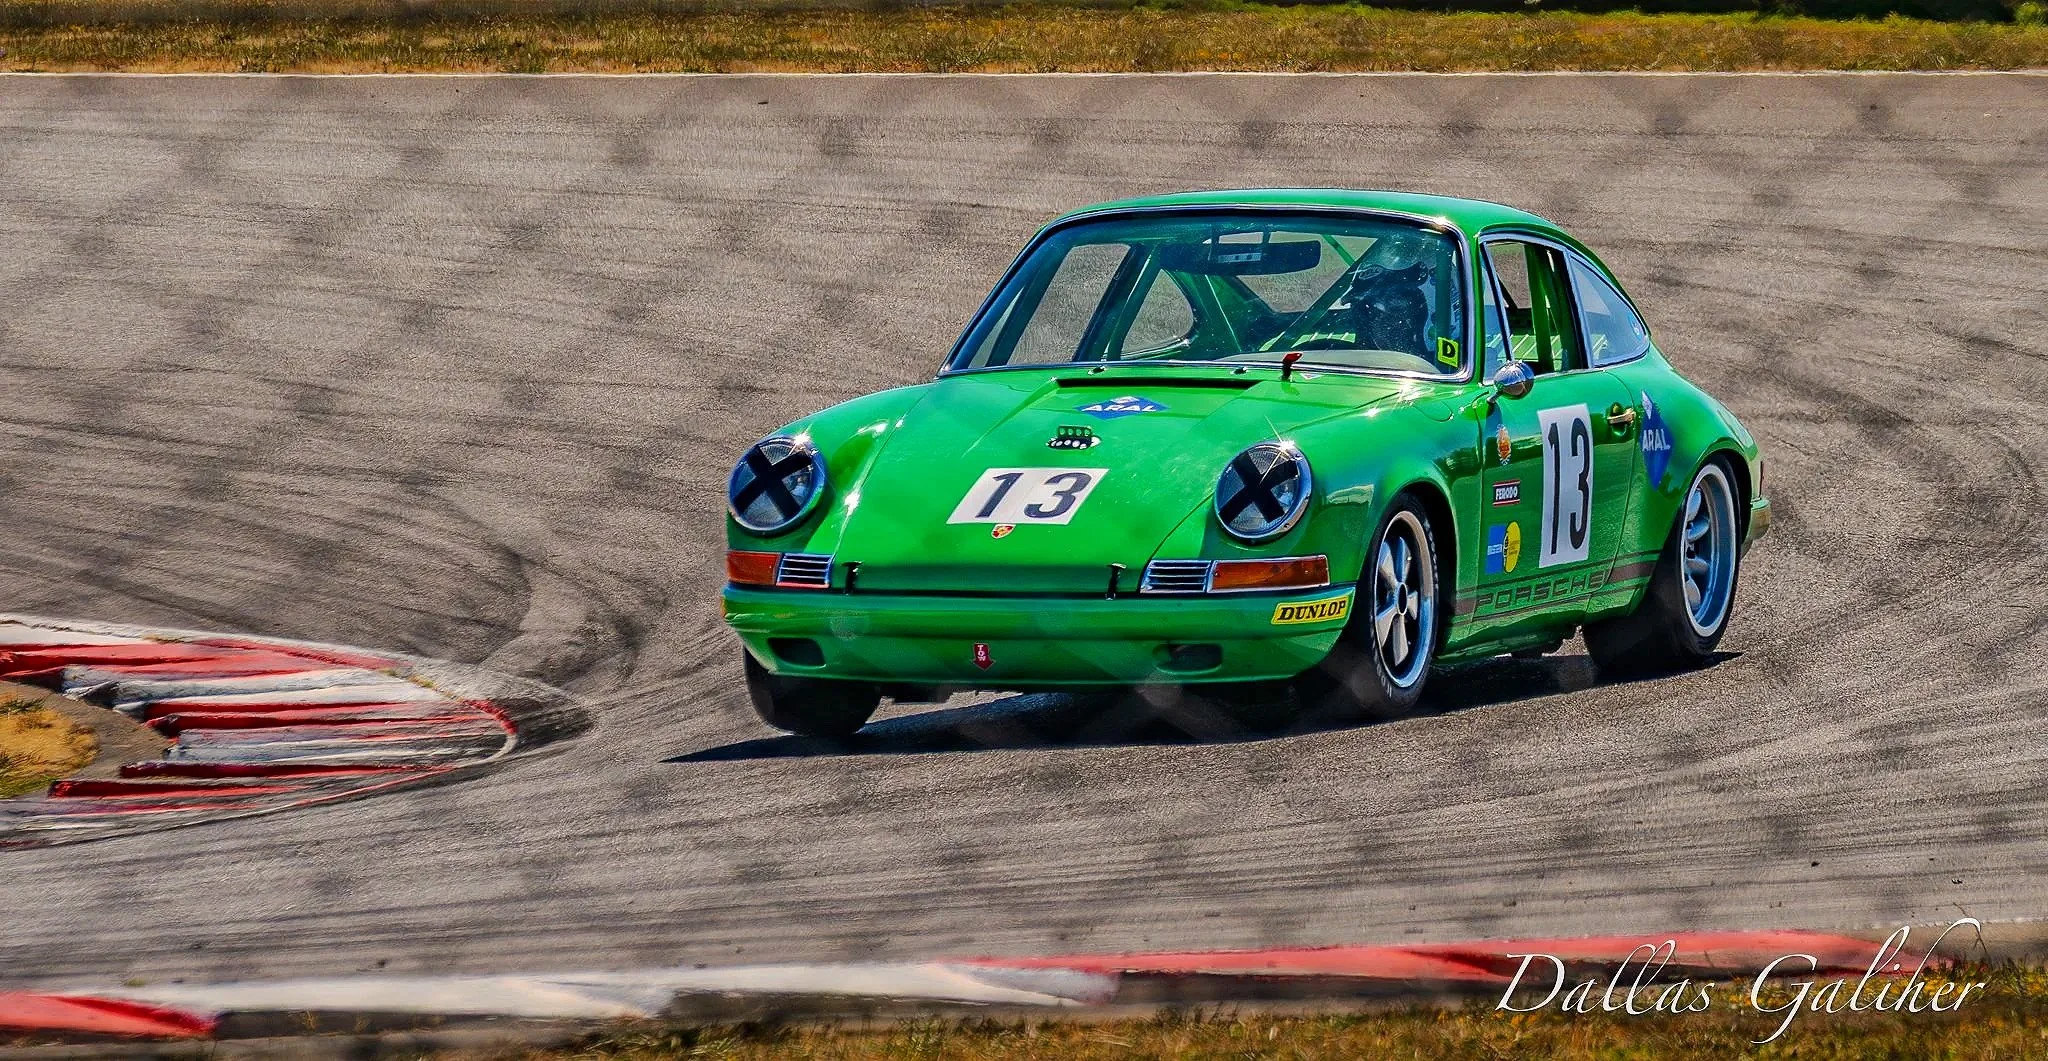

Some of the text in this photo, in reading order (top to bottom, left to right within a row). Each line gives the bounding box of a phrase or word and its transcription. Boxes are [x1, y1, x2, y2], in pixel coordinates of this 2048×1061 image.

[1442, 340, 1456, 358] D
[1081, 404, 1157, 412] ARAL
[1642, 428, 1671, 452] ARAL
[975, 472, 1092, 519] 13
[1548, 417, 1590, 555] 13
[1476, 569, 1606, 610] PORSCHE
[1276, 600, 1346, 621] DUNLOP
[977, 644, 986, 661] TOW
